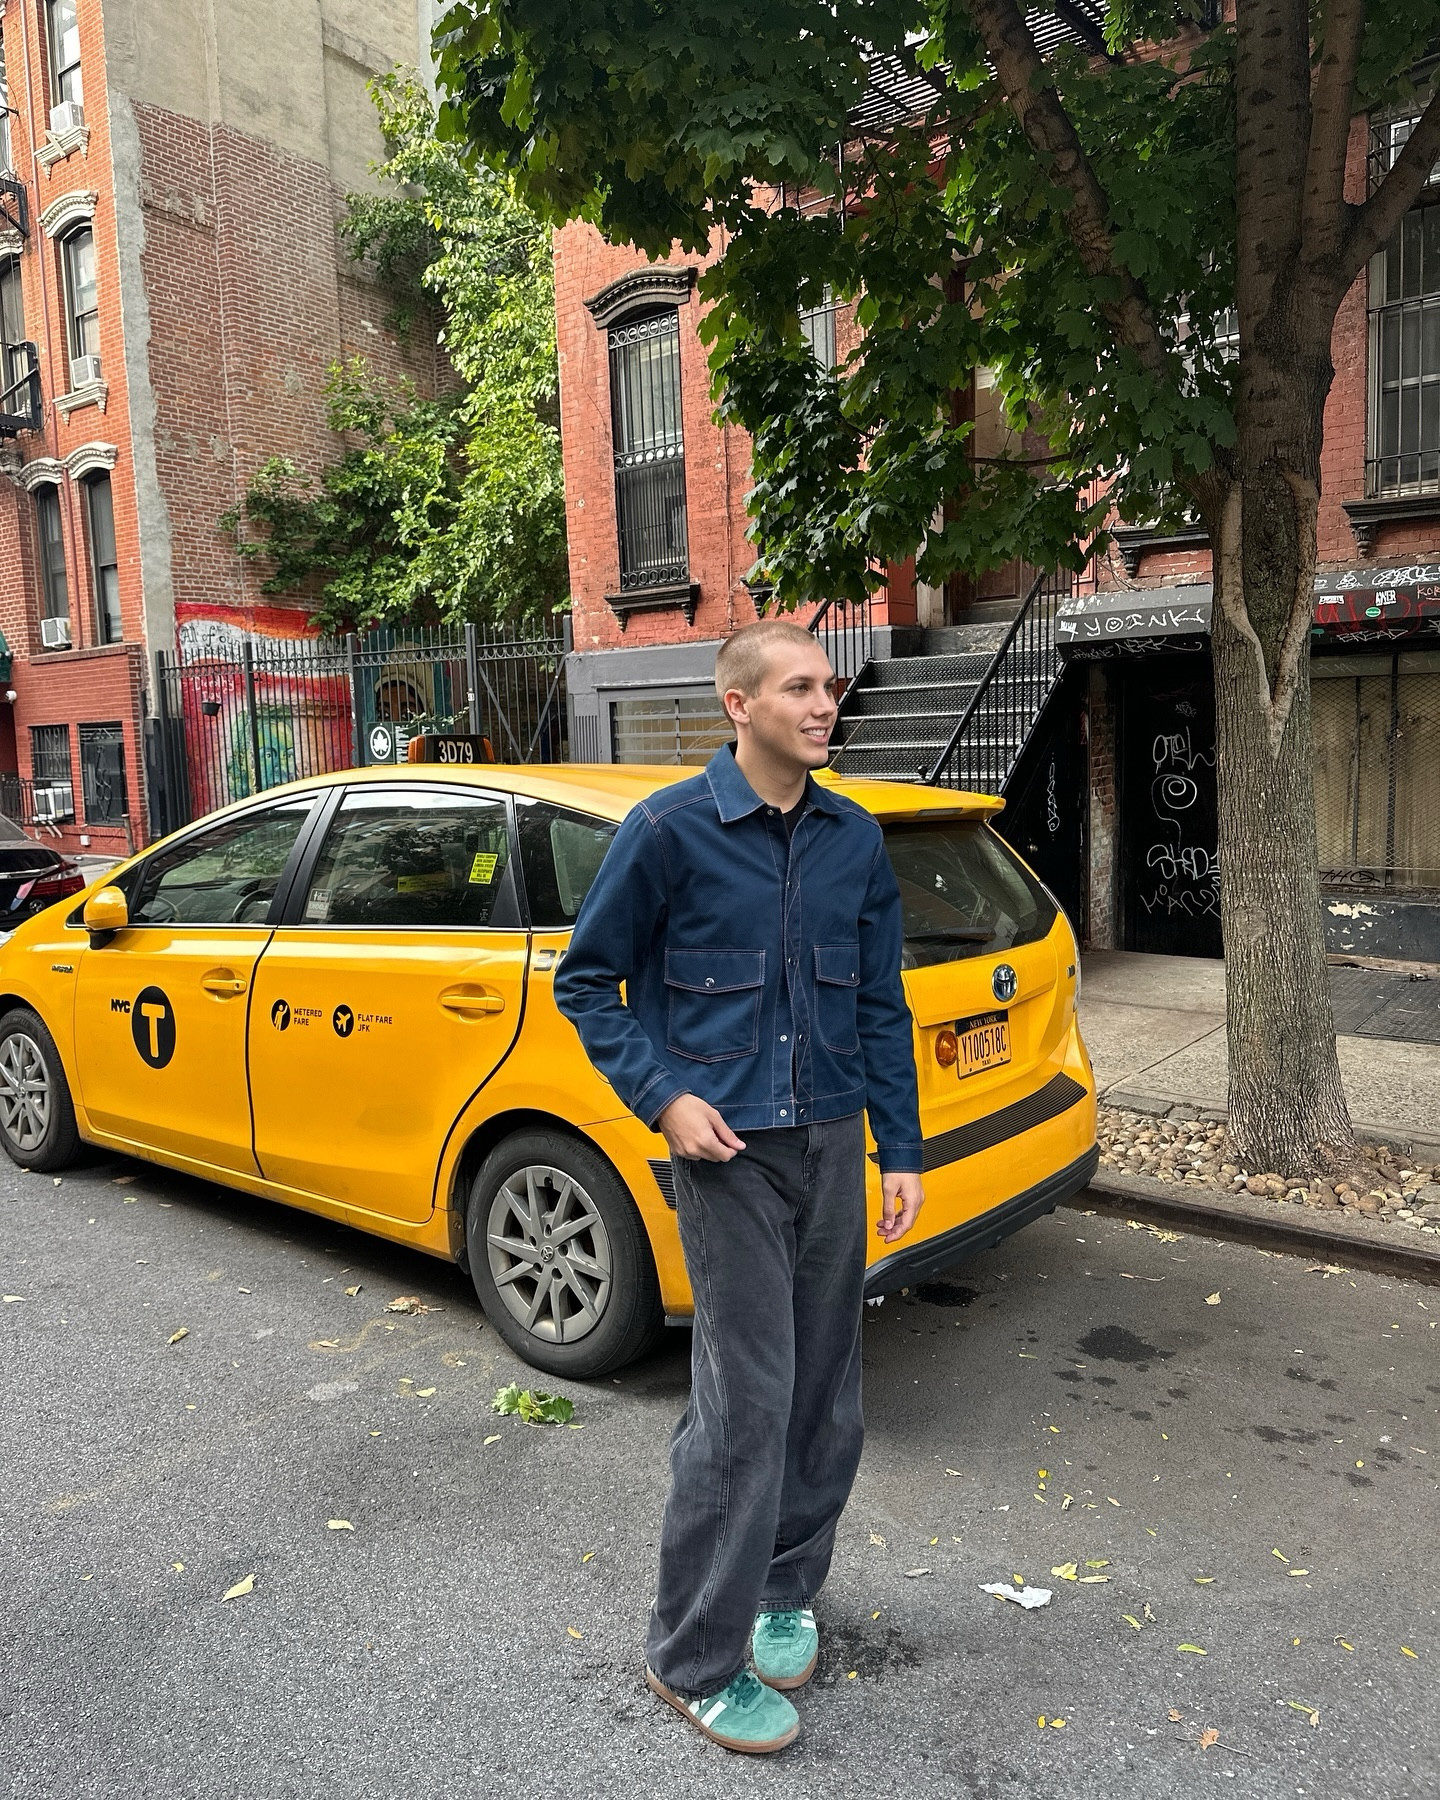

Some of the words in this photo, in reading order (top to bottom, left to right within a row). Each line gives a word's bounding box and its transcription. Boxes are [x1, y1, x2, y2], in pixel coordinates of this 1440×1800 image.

[438, 740, 473, 763] 3D79
[111, 998, 131, 1014] NYC
[293, 1008, 323, 1018] METERED
[293, 1018, 310, 1026] FARE
[357, 1013, 373, 1023] FLAT
[375, 1015, 393, 1025] FARE
[969, 1019, 983, 1029] NEW
[984, 1015, 998, 1024] YORK
[141, 1002, 166, 1058] T
[357, 1024, 371, 1032] JFK
[962, 1025, 1007, 1064] Y100518C
